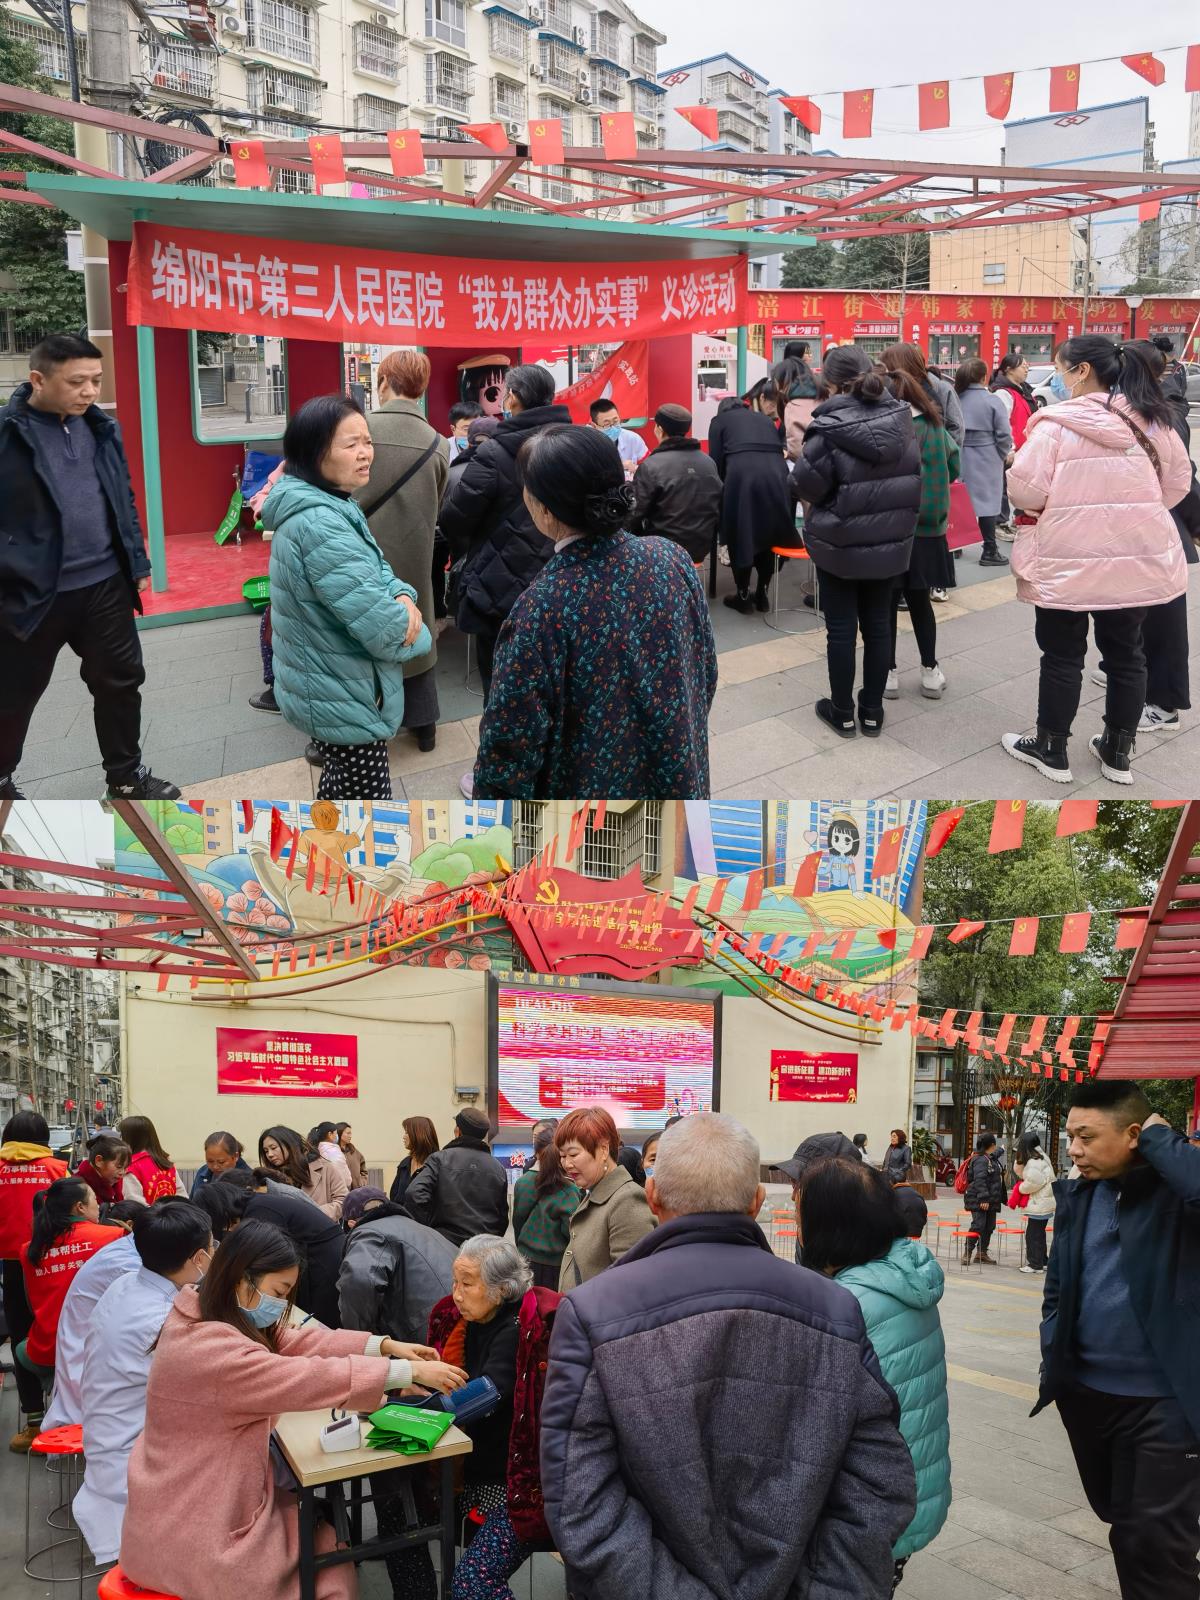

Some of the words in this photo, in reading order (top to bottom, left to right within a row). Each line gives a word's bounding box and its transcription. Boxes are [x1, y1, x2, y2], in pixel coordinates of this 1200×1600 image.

[150, 239, 445, 331] 绵阳市第三人民医院
[458, 273, 649, 332] “我为群众办实事”
[661, 269, 736, 323] 义诊活动
